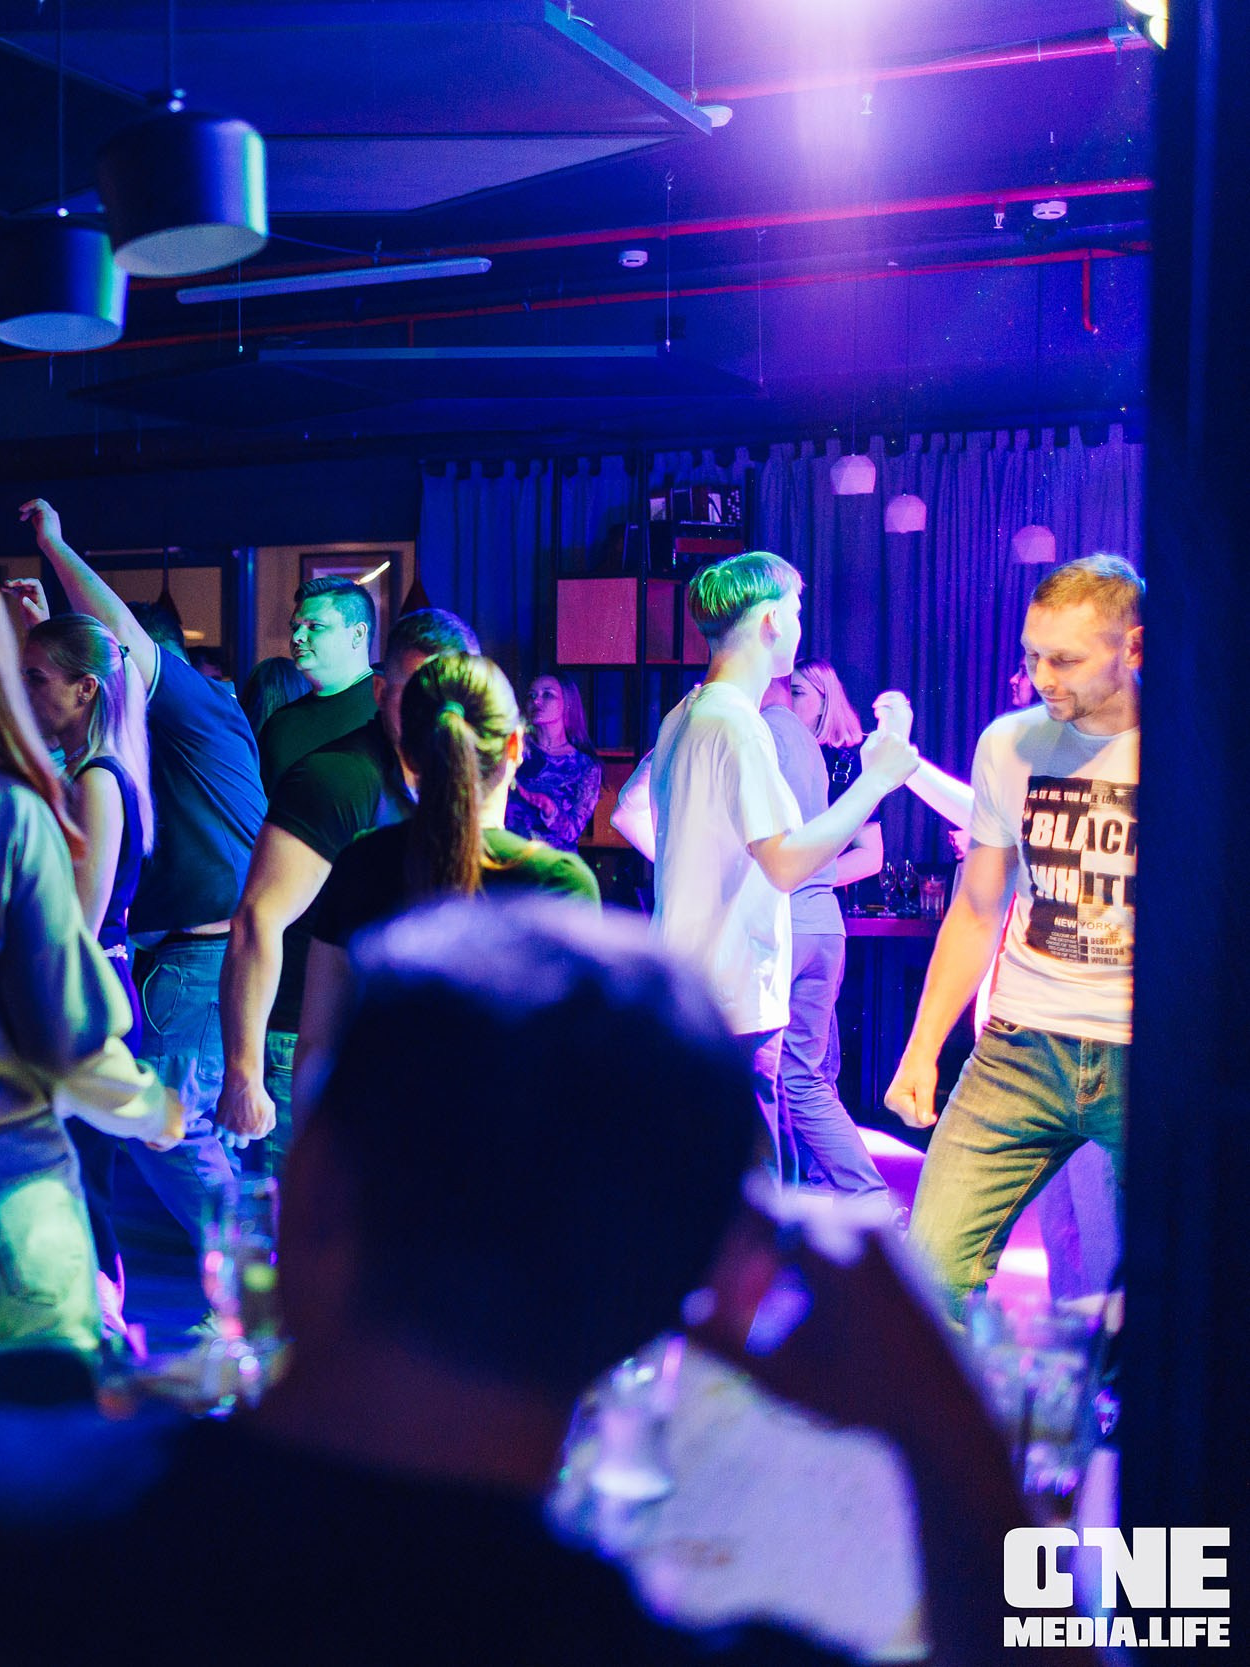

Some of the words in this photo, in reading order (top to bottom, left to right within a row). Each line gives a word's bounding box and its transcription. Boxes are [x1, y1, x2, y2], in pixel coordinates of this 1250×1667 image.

[1064, 791, 1081, 802] YOU
[1054, 917, 1077, 928] NEW
[1078, 920, 1112, 930] YORK
